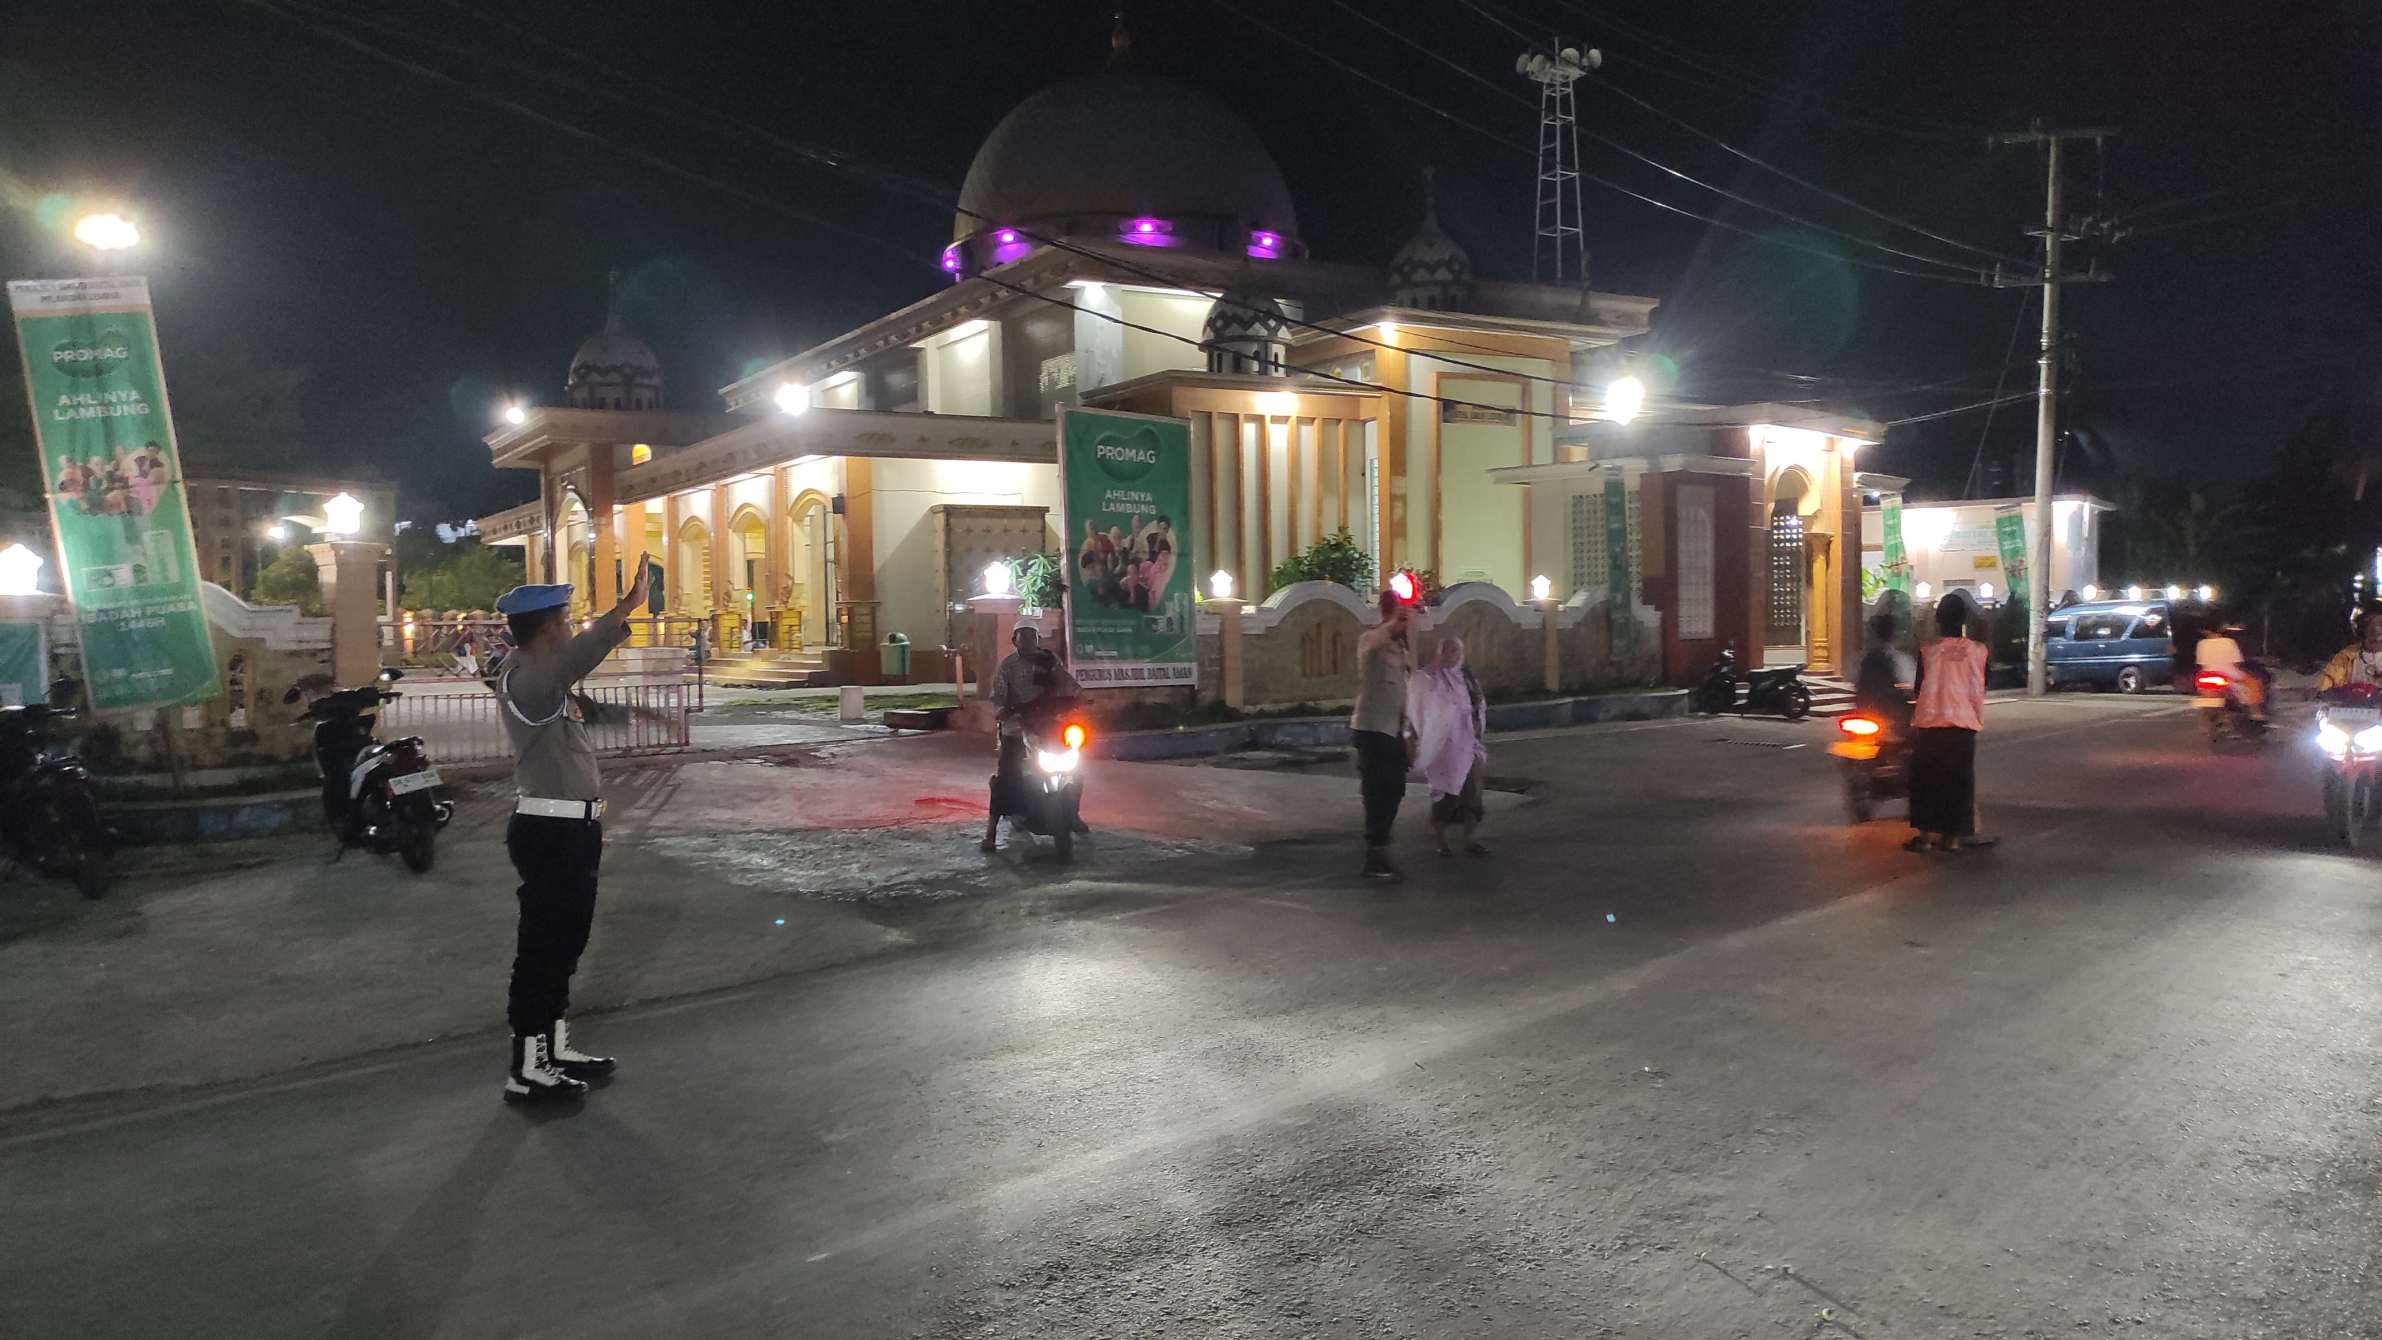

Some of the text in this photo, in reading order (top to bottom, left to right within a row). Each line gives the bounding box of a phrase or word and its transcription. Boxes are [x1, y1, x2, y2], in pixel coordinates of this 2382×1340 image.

[53, 347, 128, 363] PROMAG
[58, 390, 142, 406] AHLINYA
[52, 402, 150, 421] LAMBUNG
[1096, 445, 1156, 464] PROMAG
[1104, 489, 1153, 502] AHLINYA
[1102, 501, 1157, 515] LAMBUNG
